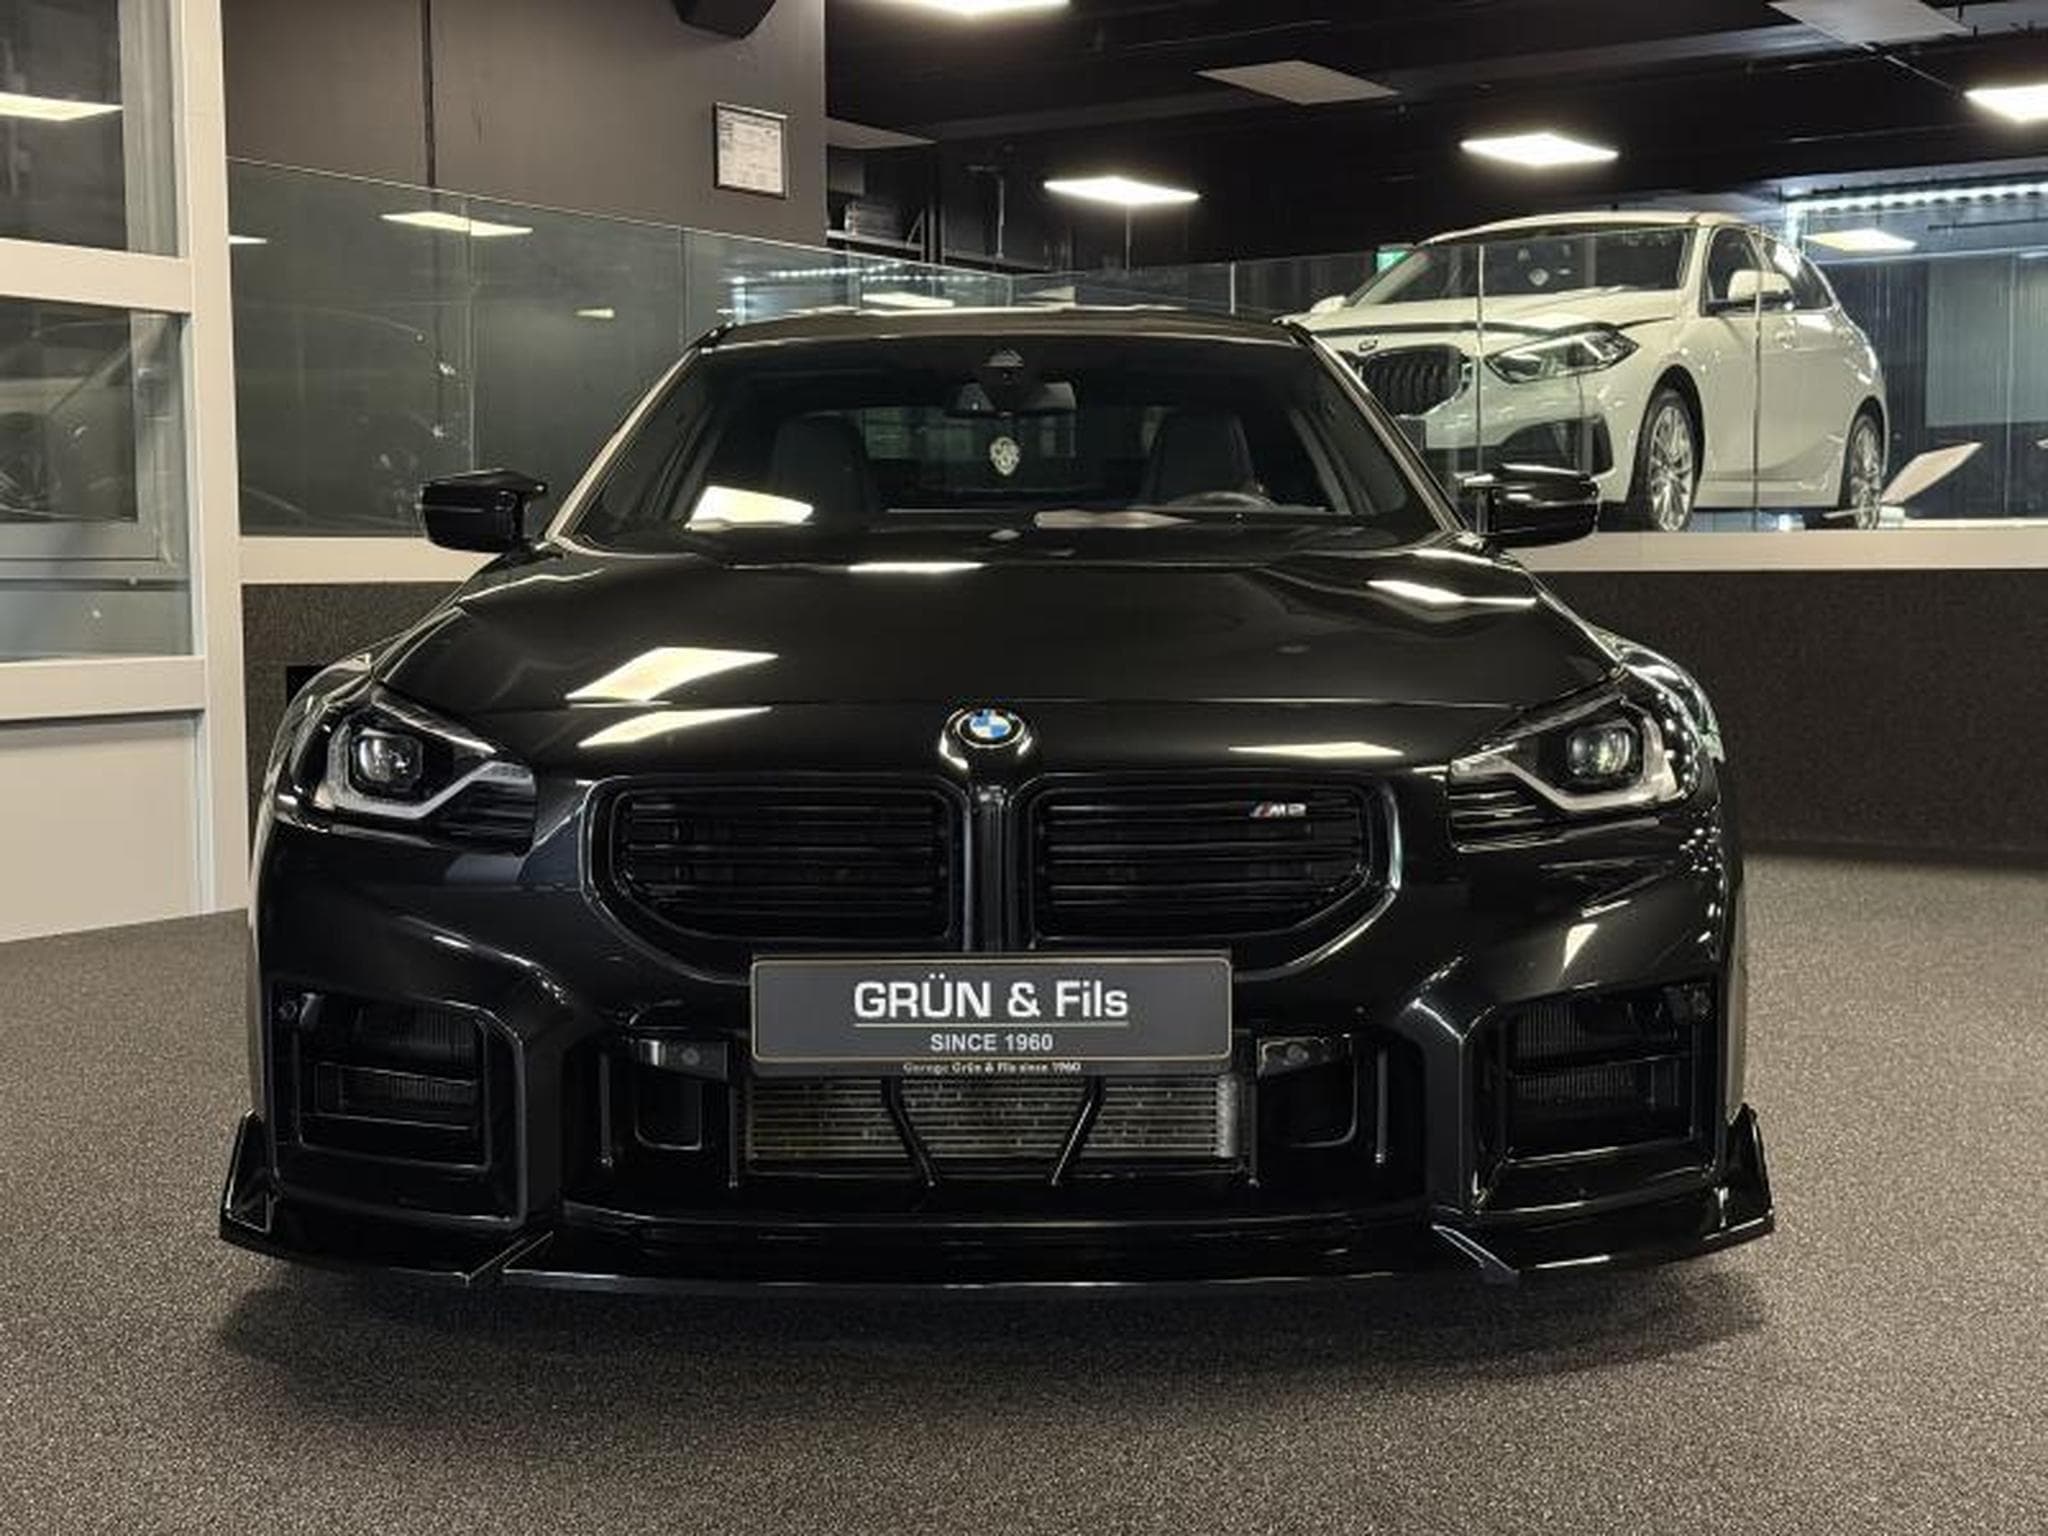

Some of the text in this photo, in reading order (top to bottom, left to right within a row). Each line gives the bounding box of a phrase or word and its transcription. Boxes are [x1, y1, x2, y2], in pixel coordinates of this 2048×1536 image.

[854, 973, 1129, 1018] GRÜN & Fils
[930, 1033, 1053, 1051] SINCE 1960
